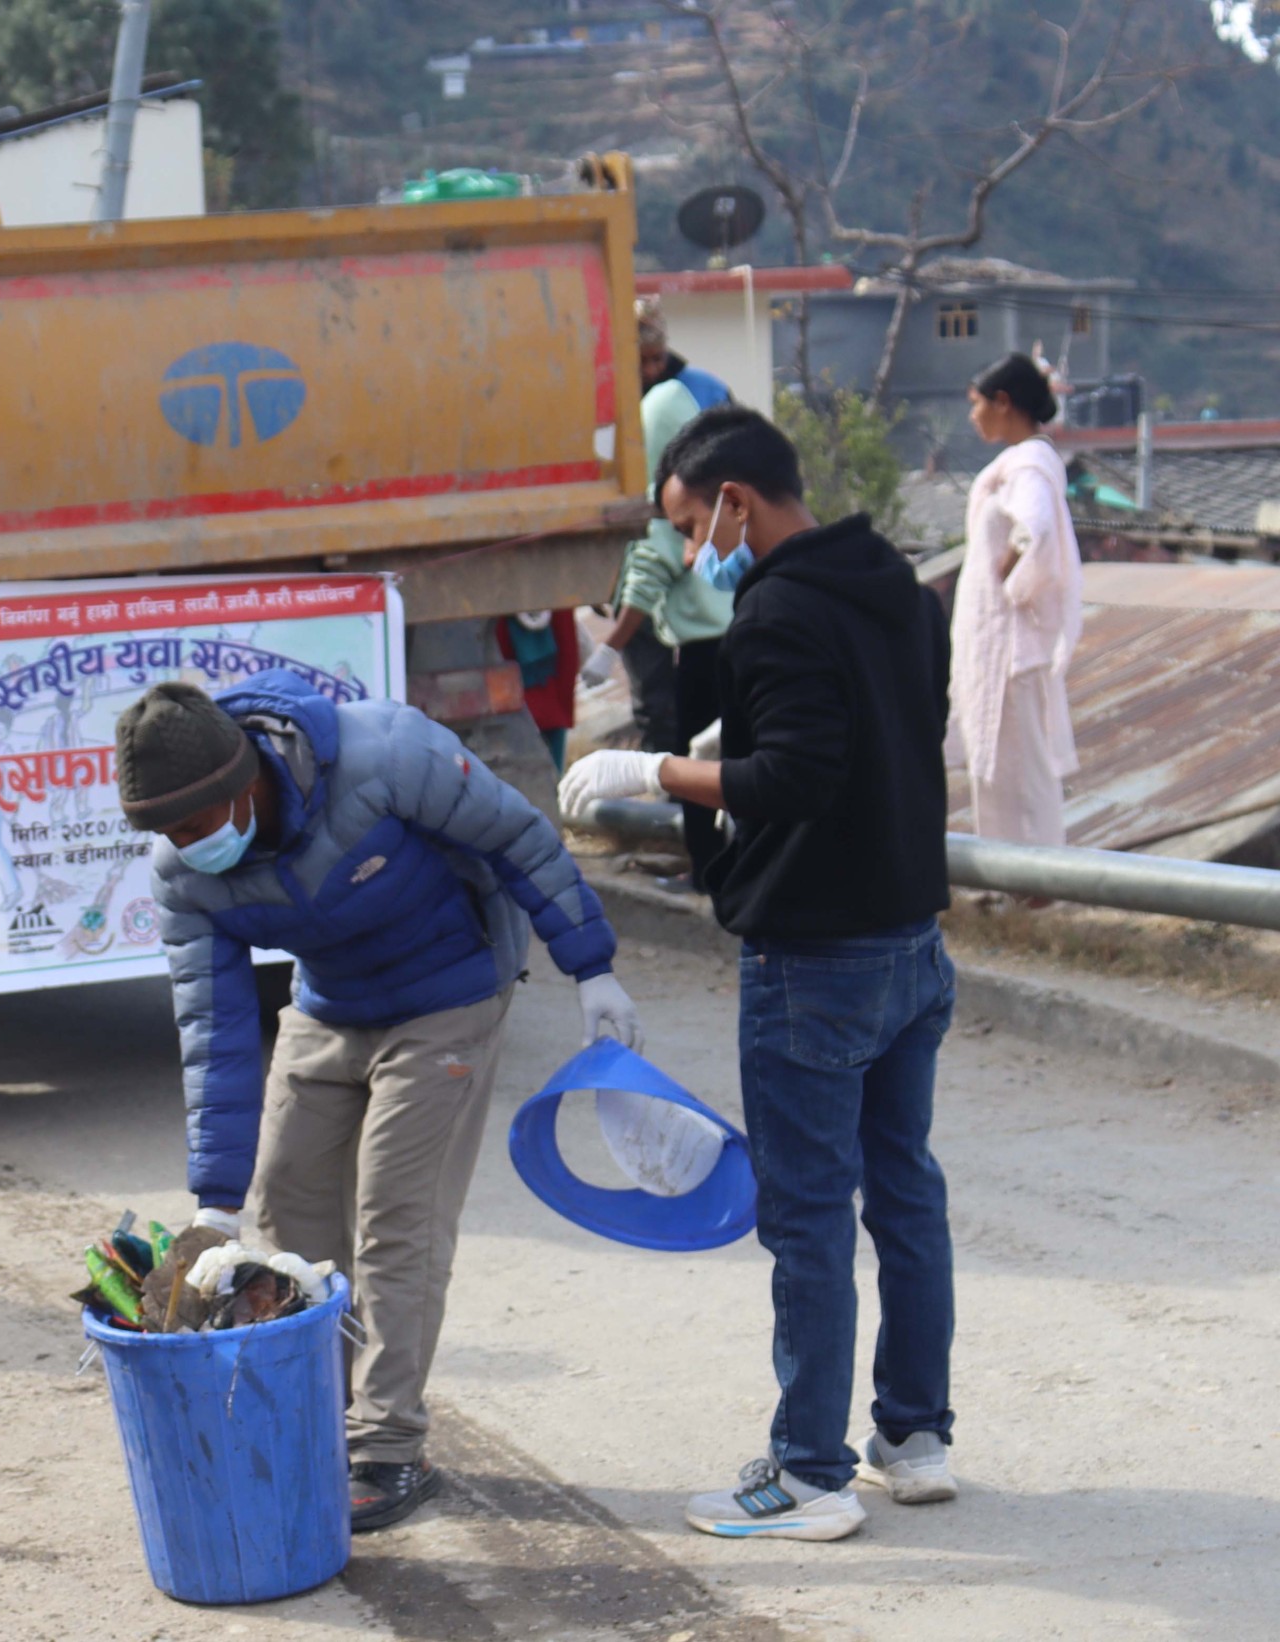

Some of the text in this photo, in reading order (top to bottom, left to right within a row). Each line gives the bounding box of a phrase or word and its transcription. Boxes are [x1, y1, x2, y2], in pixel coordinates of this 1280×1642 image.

[112, 638, 183, 684] युवा
[61, 818, 139, 842] २०८०/०
[64, 839, 153, 866] बडीमालिक
